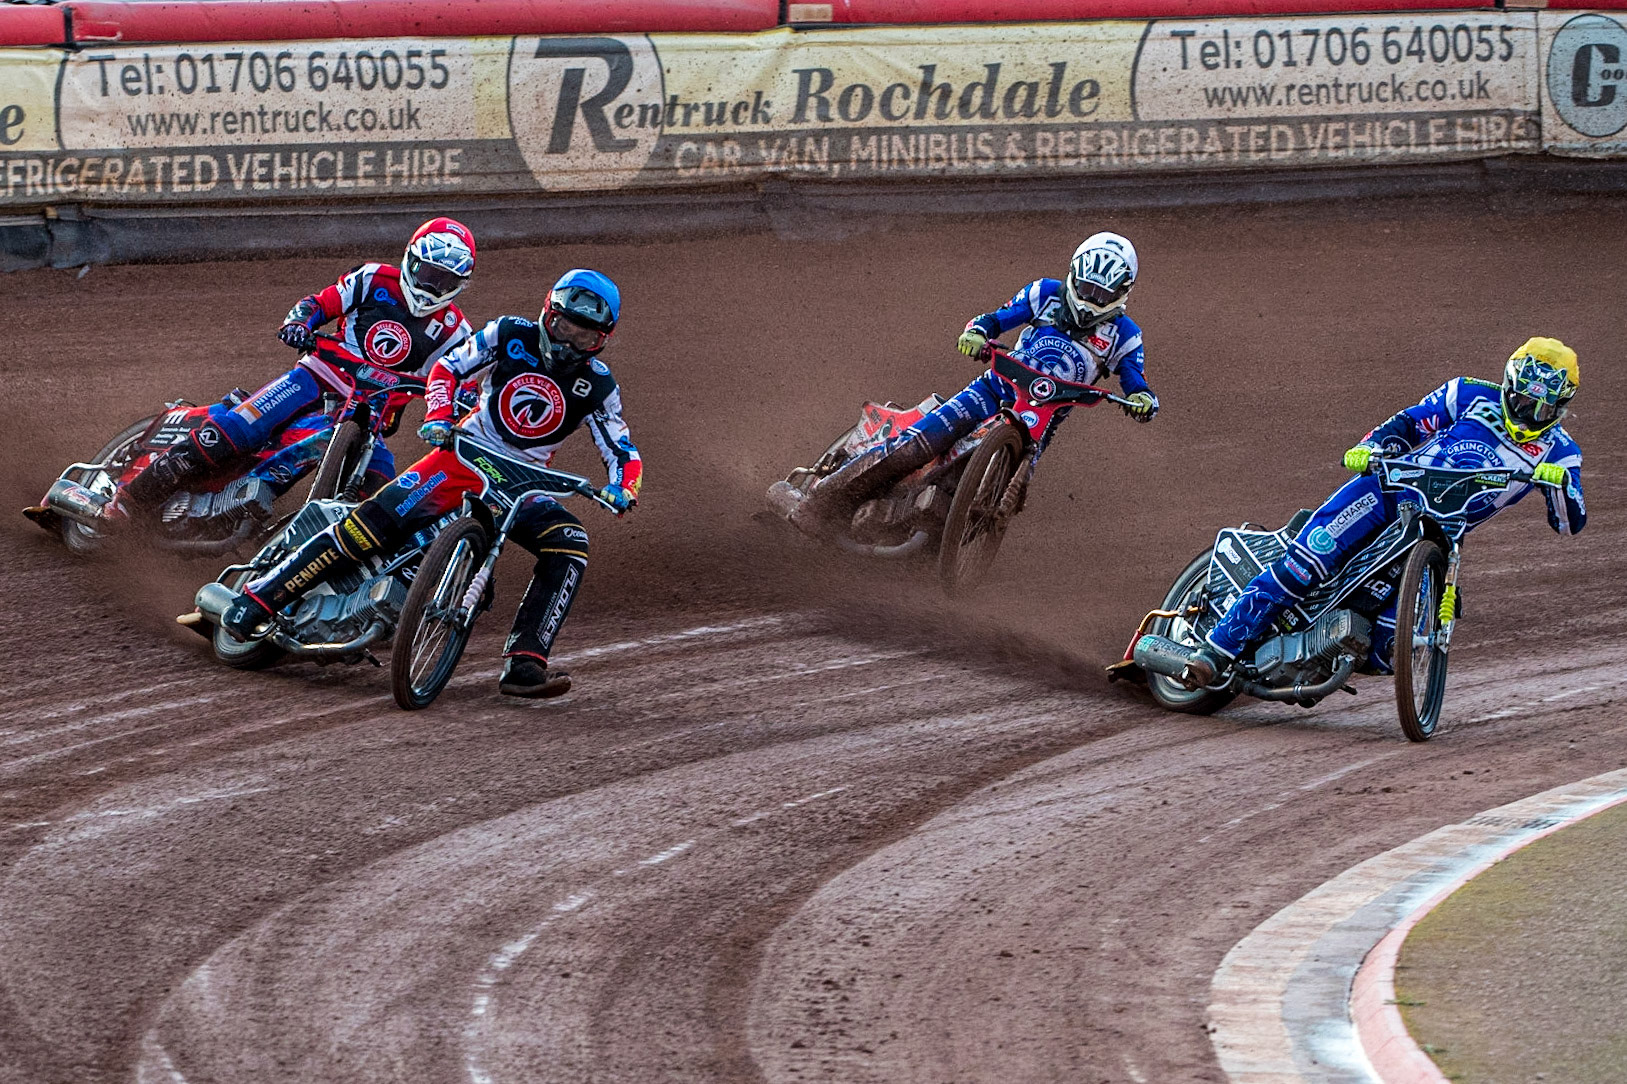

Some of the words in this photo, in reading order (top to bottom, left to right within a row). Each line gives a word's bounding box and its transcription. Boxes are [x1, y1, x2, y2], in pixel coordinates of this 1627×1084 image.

[1169, 29, 1242, 70] Tel:
[1252, 26, 1371, 68] 01706
[1382, 24, 1514, 65] 640055
[88, 54, 164, 97] Tel:
[174, 51, 296, 95] 01706
[307, 48, 450, 92] 640055
[787, 61, 1101, 125] Rochdale
[1202, 71, 1491, 108] www.rentruck.co.uk
[127, 101, 423, 137] www.rentruck.co.uk
[674, 141, 749, 177] CAR
[849, 132, 996, 171] MINIBUS
[1004, 131, 1027, 168] &
[1034, 123, 1295, 167] REFRIGERATED
[1302, 118, 1450, 158] VEHICLE
[1456, 115, 1528, 151] HIRE
[227, 149, 375, 191] VEHICLE
[385, 148, 464, 187] HIRE
[253, 379, 292, 408] INTUITIVE
[260, 383, 301, 414] TRAINING
[512, 376, 535, 389] BELLE
[536, 378, 552, 390] VUE
[550, 389, 562, 414] COLTS
[1327, 494, 1376, 534] INCHARGE
[284, 547, 340, 593] PENRITE
